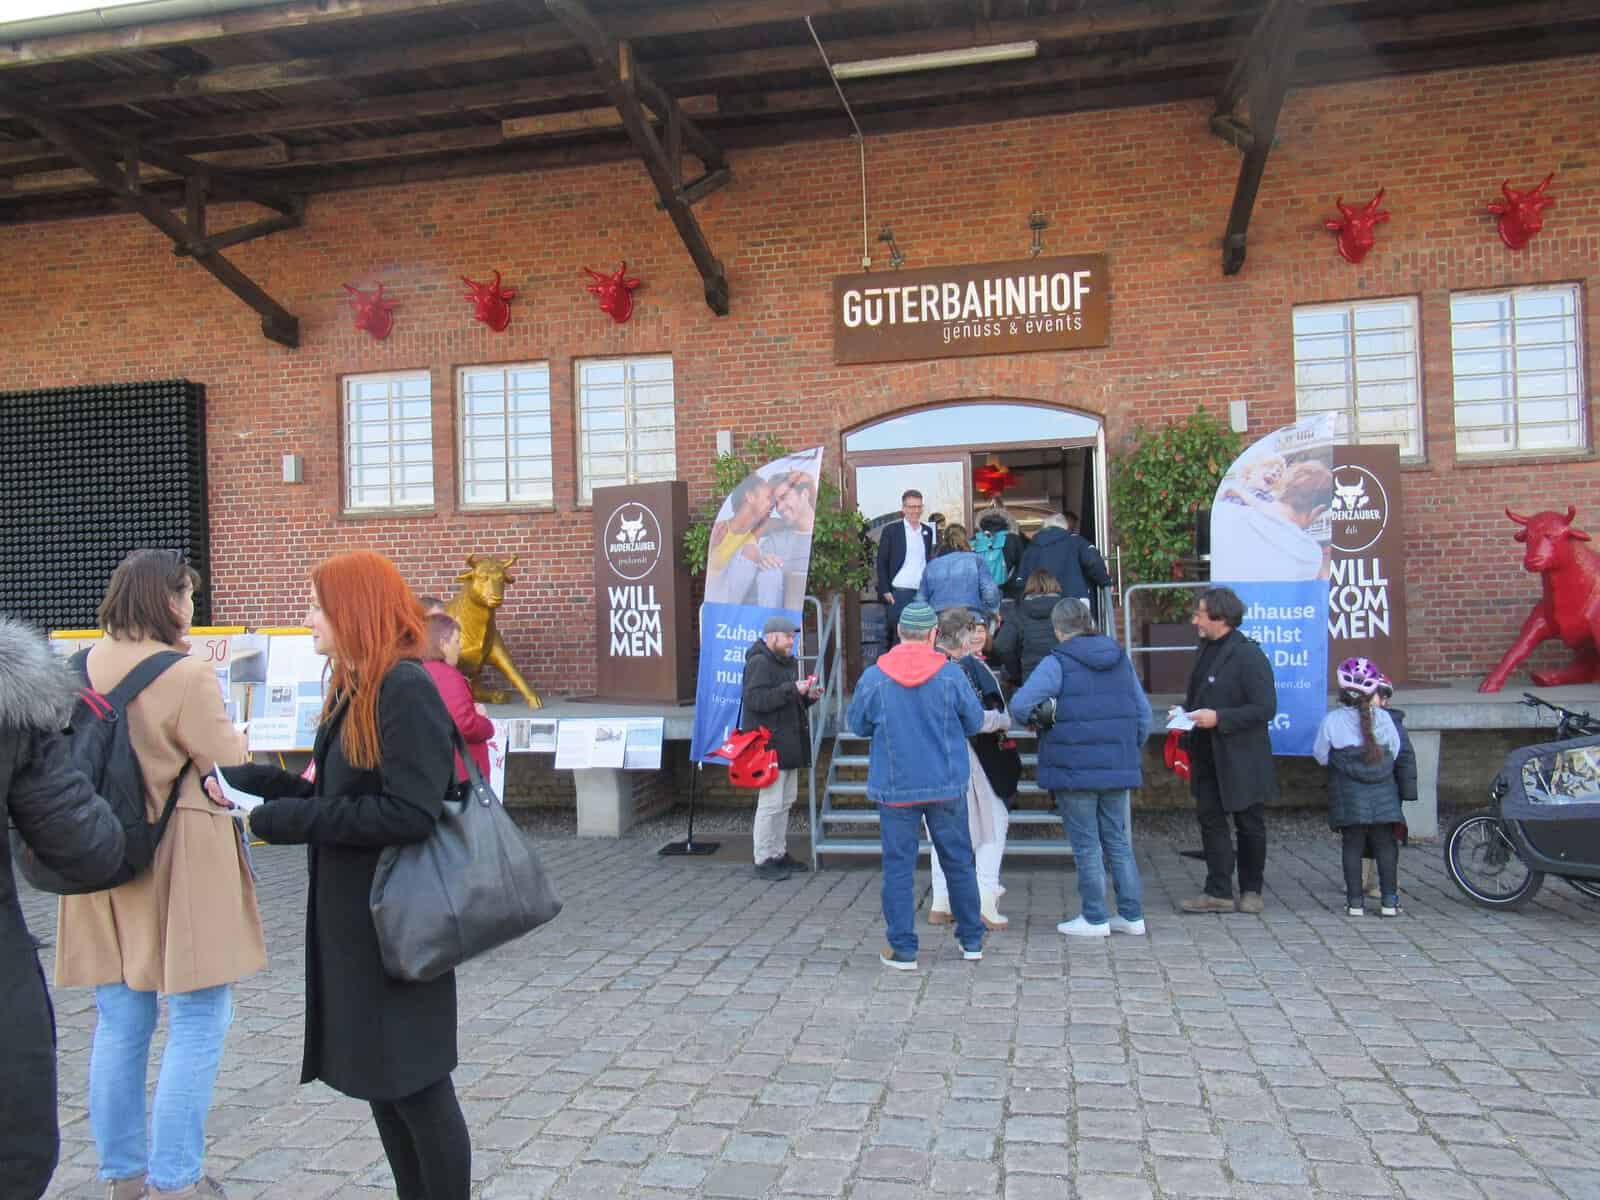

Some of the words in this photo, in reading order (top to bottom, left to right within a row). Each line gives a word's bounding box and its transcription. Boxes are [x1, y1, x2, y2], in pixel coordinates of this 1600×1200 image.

[943, 320, 1001, 344] genuss
[1009, 321, 1018, 335] &
[1026, 315, 1082, 334] events
[607, 585, 661, 611] WILL
[609, 609, 662, 633] KOM
[715, 623, 763, 641] Zuha
[609, 631, 663, 657] MEN
[1274, 649, 1309, 667] Du!
